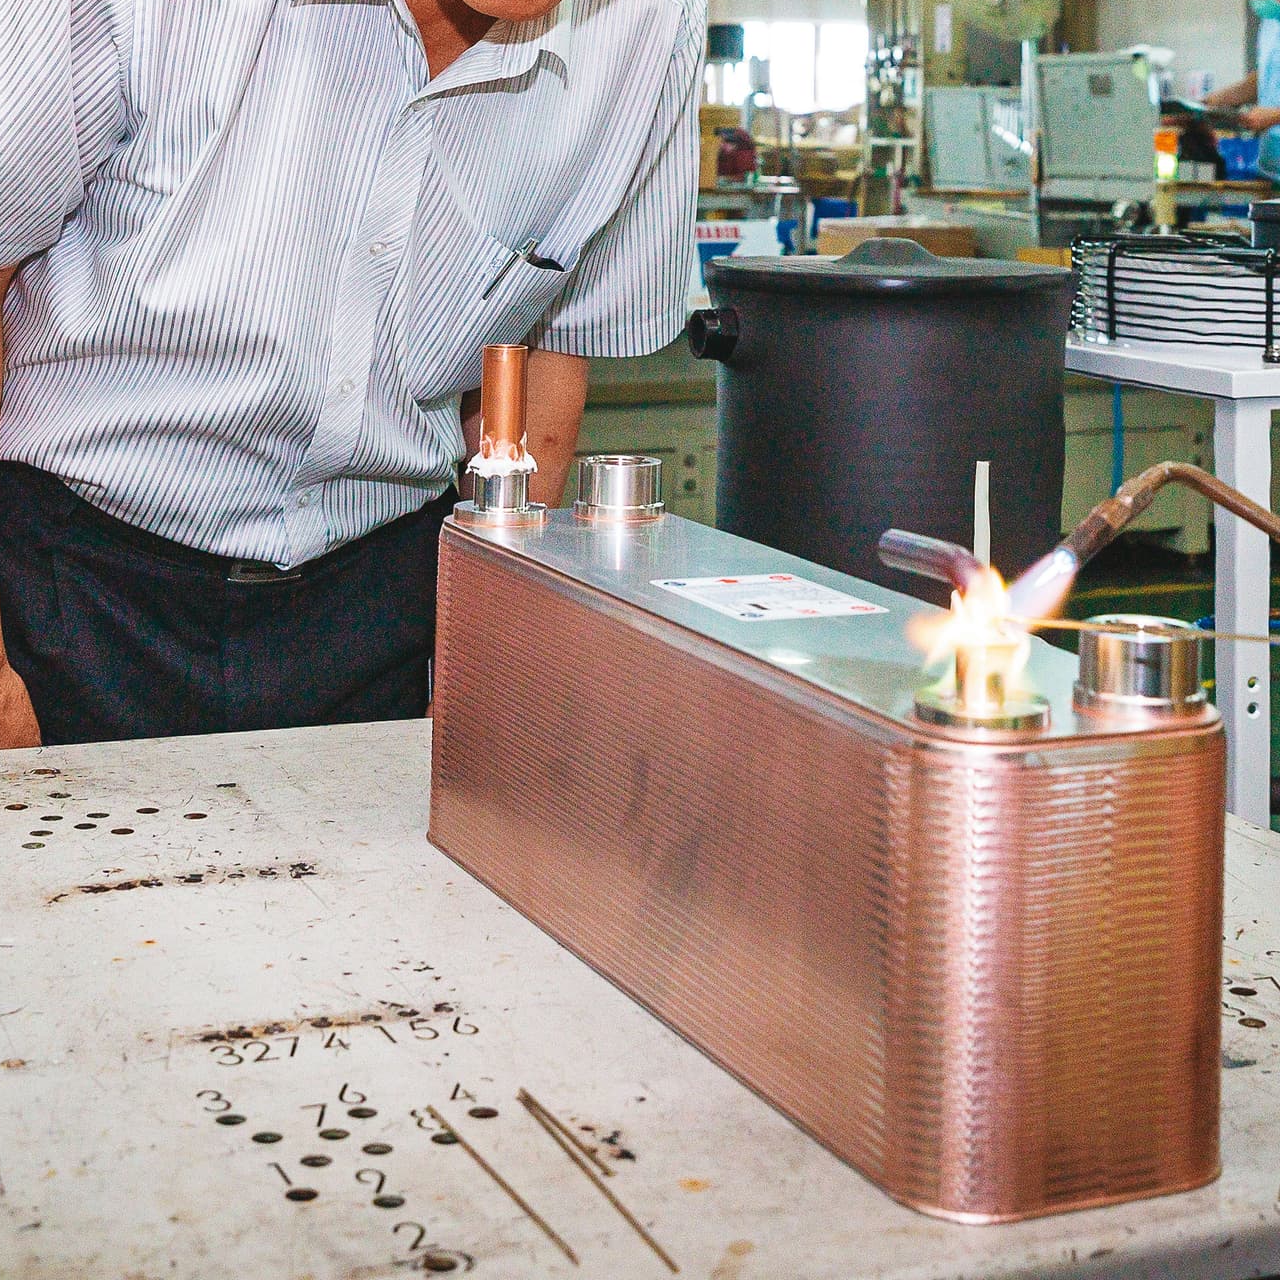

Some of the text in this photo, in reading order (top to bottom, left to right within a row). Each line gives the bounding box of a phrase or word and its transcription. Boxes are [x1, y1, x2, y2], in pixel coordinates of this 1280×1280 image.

[195, 1088, 233, 1113] 3
[337, 1082, 368, 1105] 6
[449, 1082, 477, 1103] 4
[299, 1102, 328, 1128] 7
